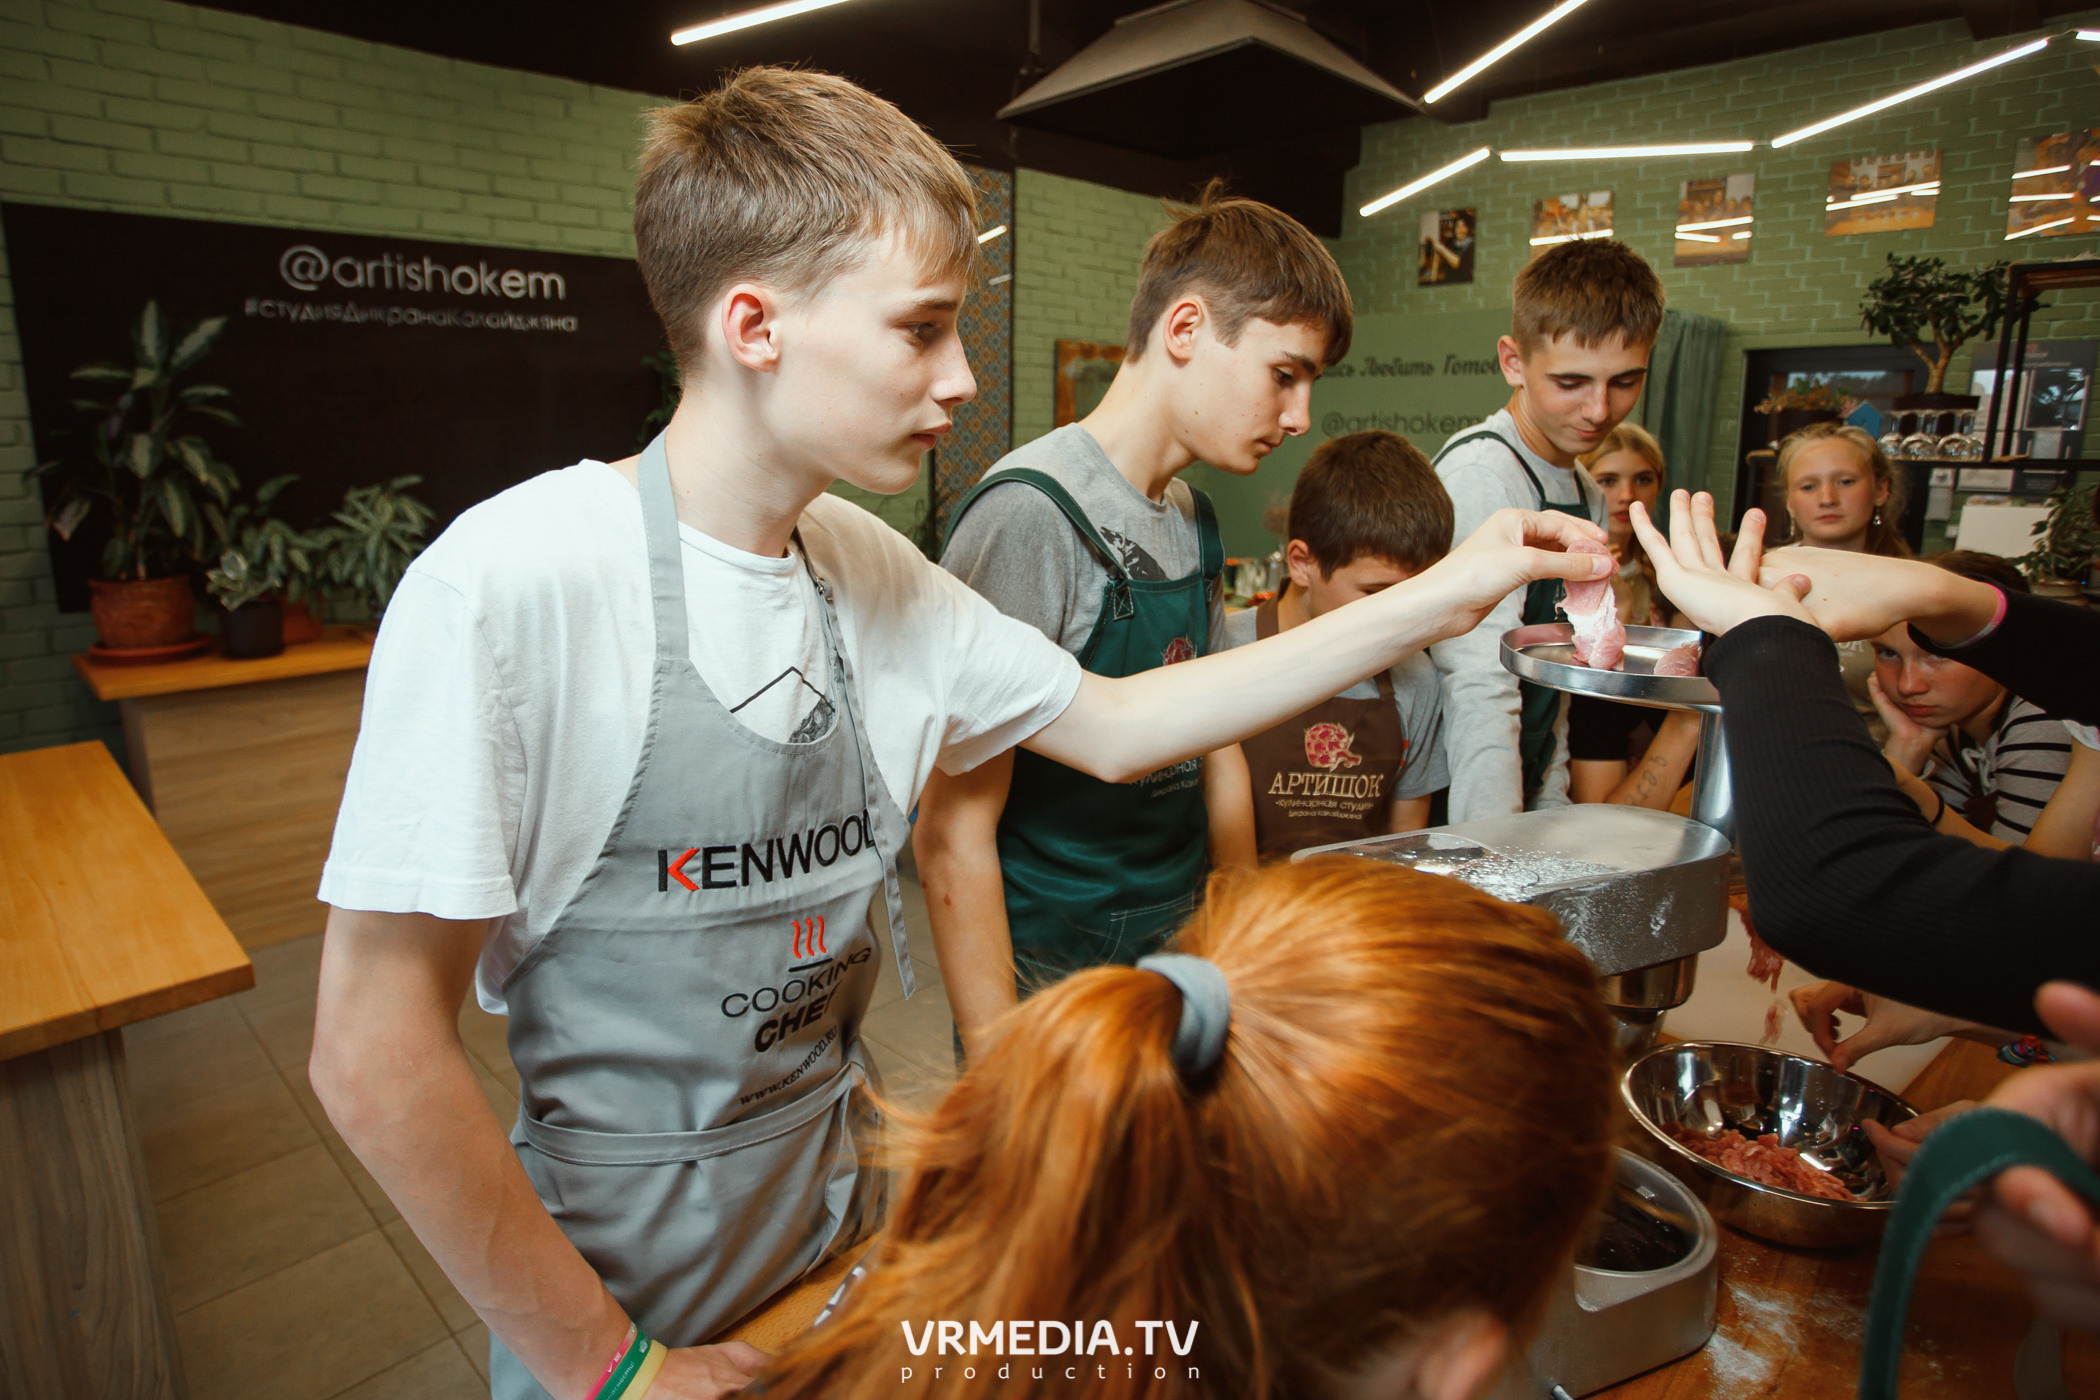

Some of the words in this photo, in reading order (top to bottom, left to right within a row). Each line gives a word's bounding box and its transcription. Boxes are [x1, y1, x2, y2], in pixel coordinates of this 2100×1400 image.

[279, 244, 566, 300] @artishokem
[1268, 771, 1384, 798] АРТИШОК
[721, 947, 872, 1018] COOKING
